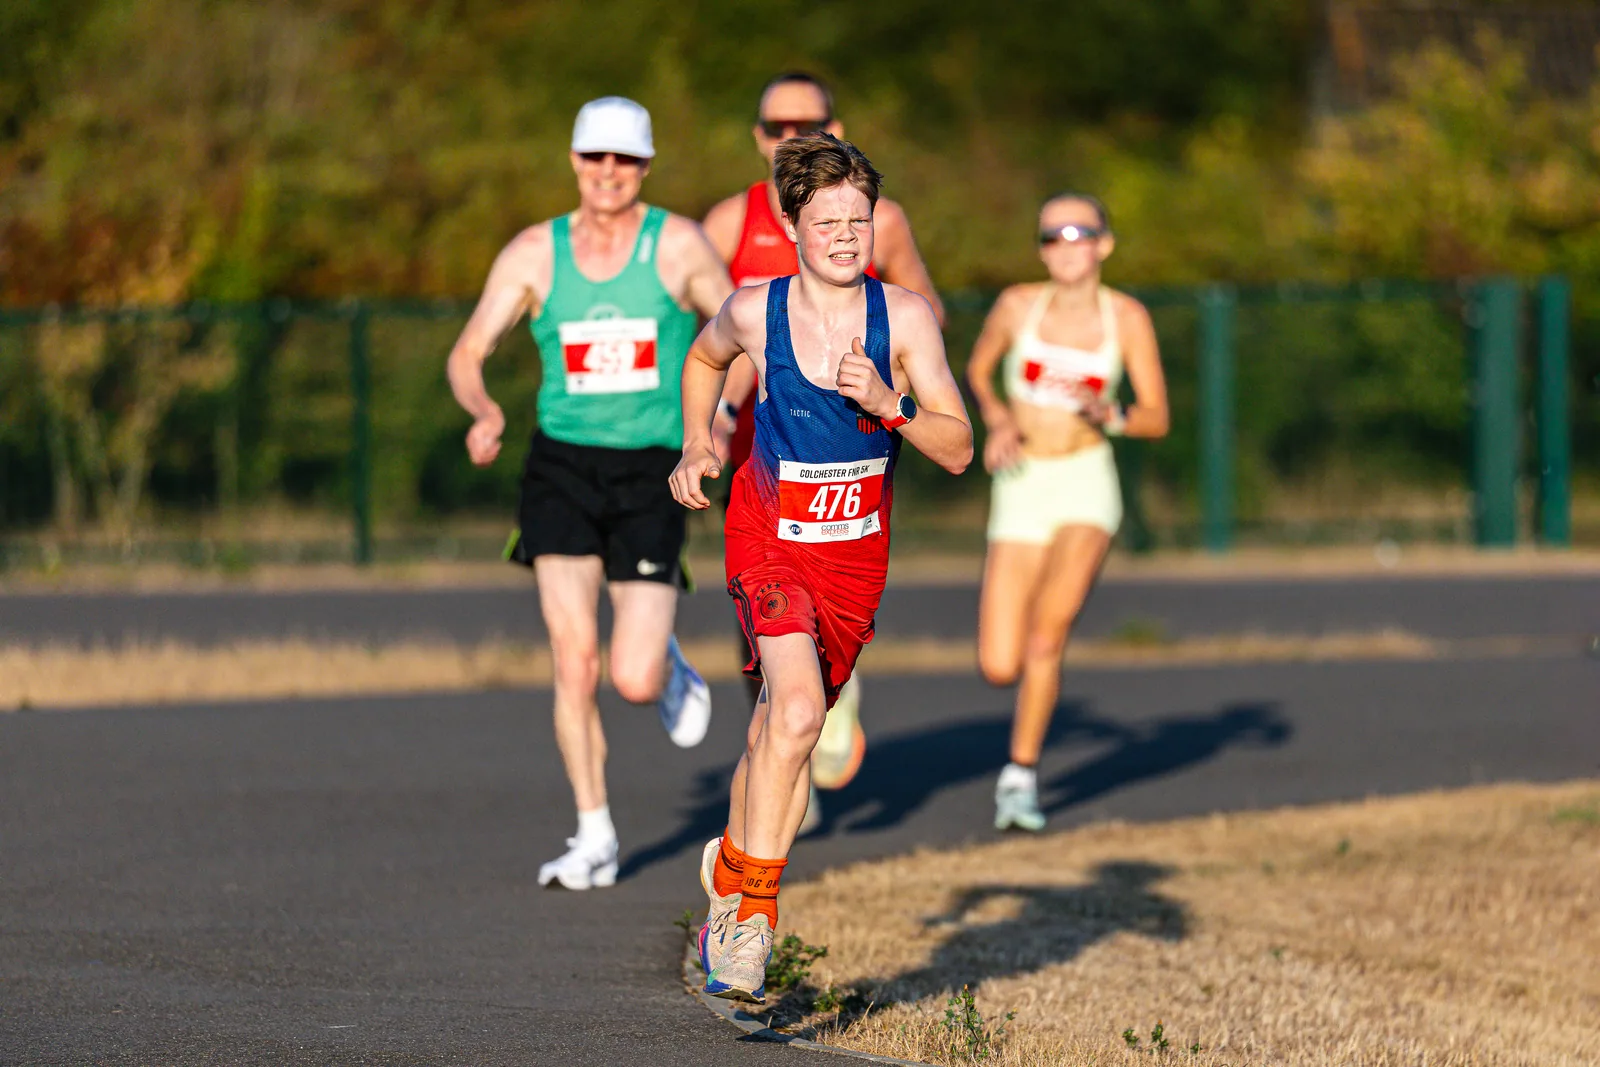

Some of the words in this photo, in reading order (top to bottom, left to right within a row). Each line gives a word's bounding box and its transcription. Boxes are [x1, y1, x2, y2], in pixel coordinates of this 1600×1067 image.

[790, 408, 811, 418] TACTIC
[799, 468, 847, 479] COLCHESTER
[847, 466, 861, 477] FNR
[860, 464, 871, 474] 5K
[808, 482, 862, 520] 476
[821, 522, 849, 531] comms
